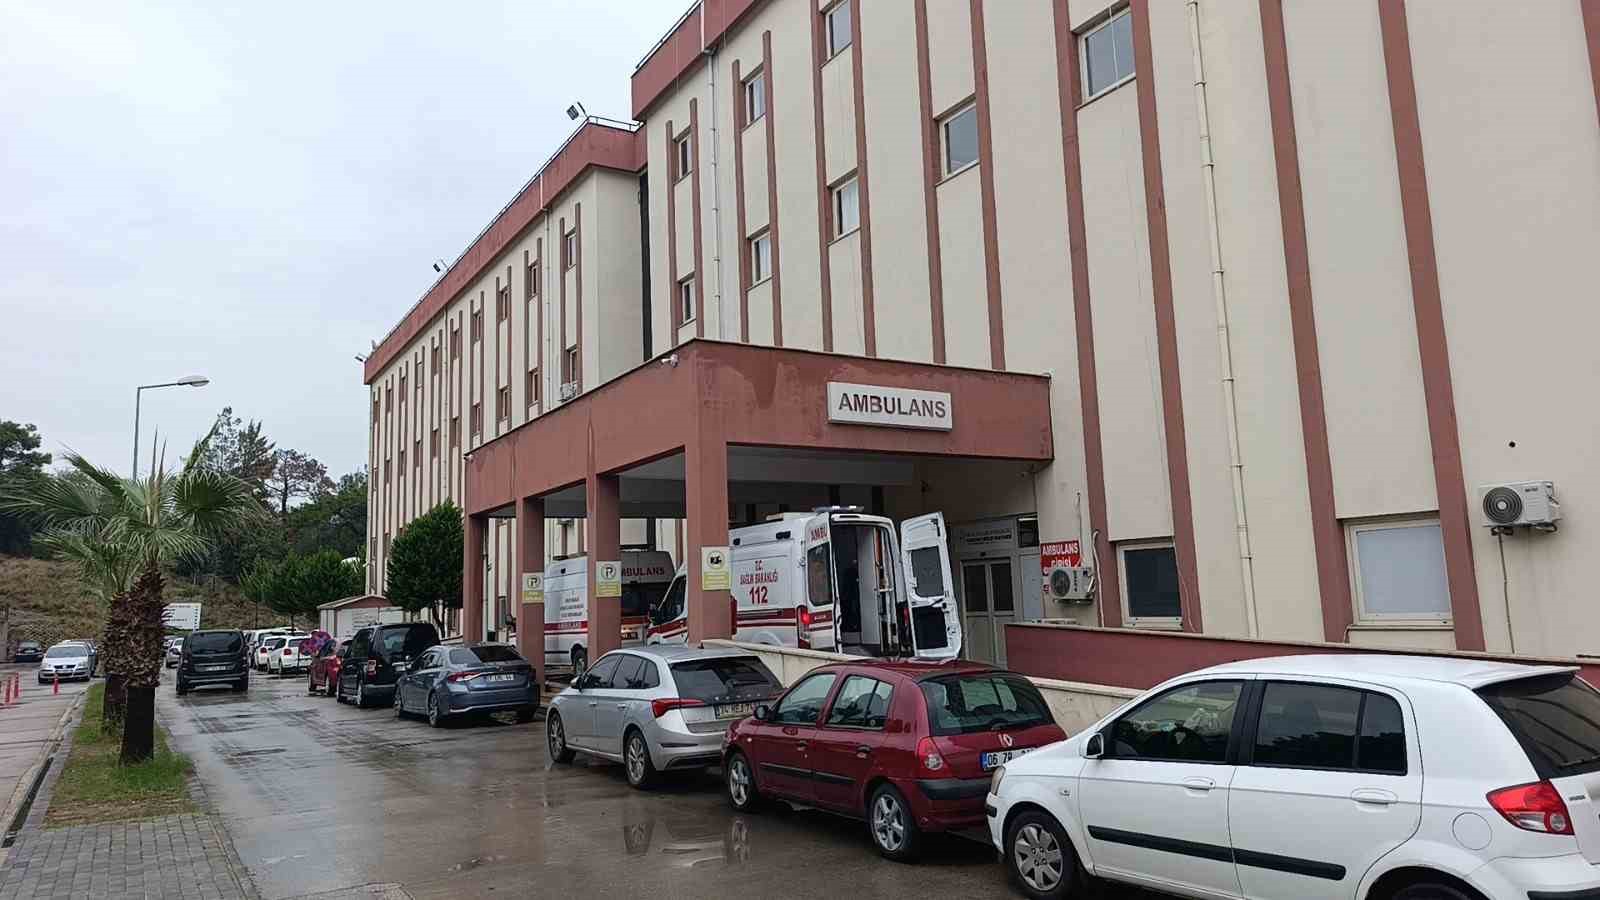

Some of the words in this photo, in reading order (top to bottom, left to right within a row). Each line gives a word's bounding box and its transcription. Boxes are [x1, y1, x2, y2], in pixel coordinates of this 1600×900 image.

[838, 392, 947, 419] AMBULANS
[1042, 542, 1079, 556] AMBULANS
[749, 585, 769, 605] 112
[987, 753, 999, 767] 06
